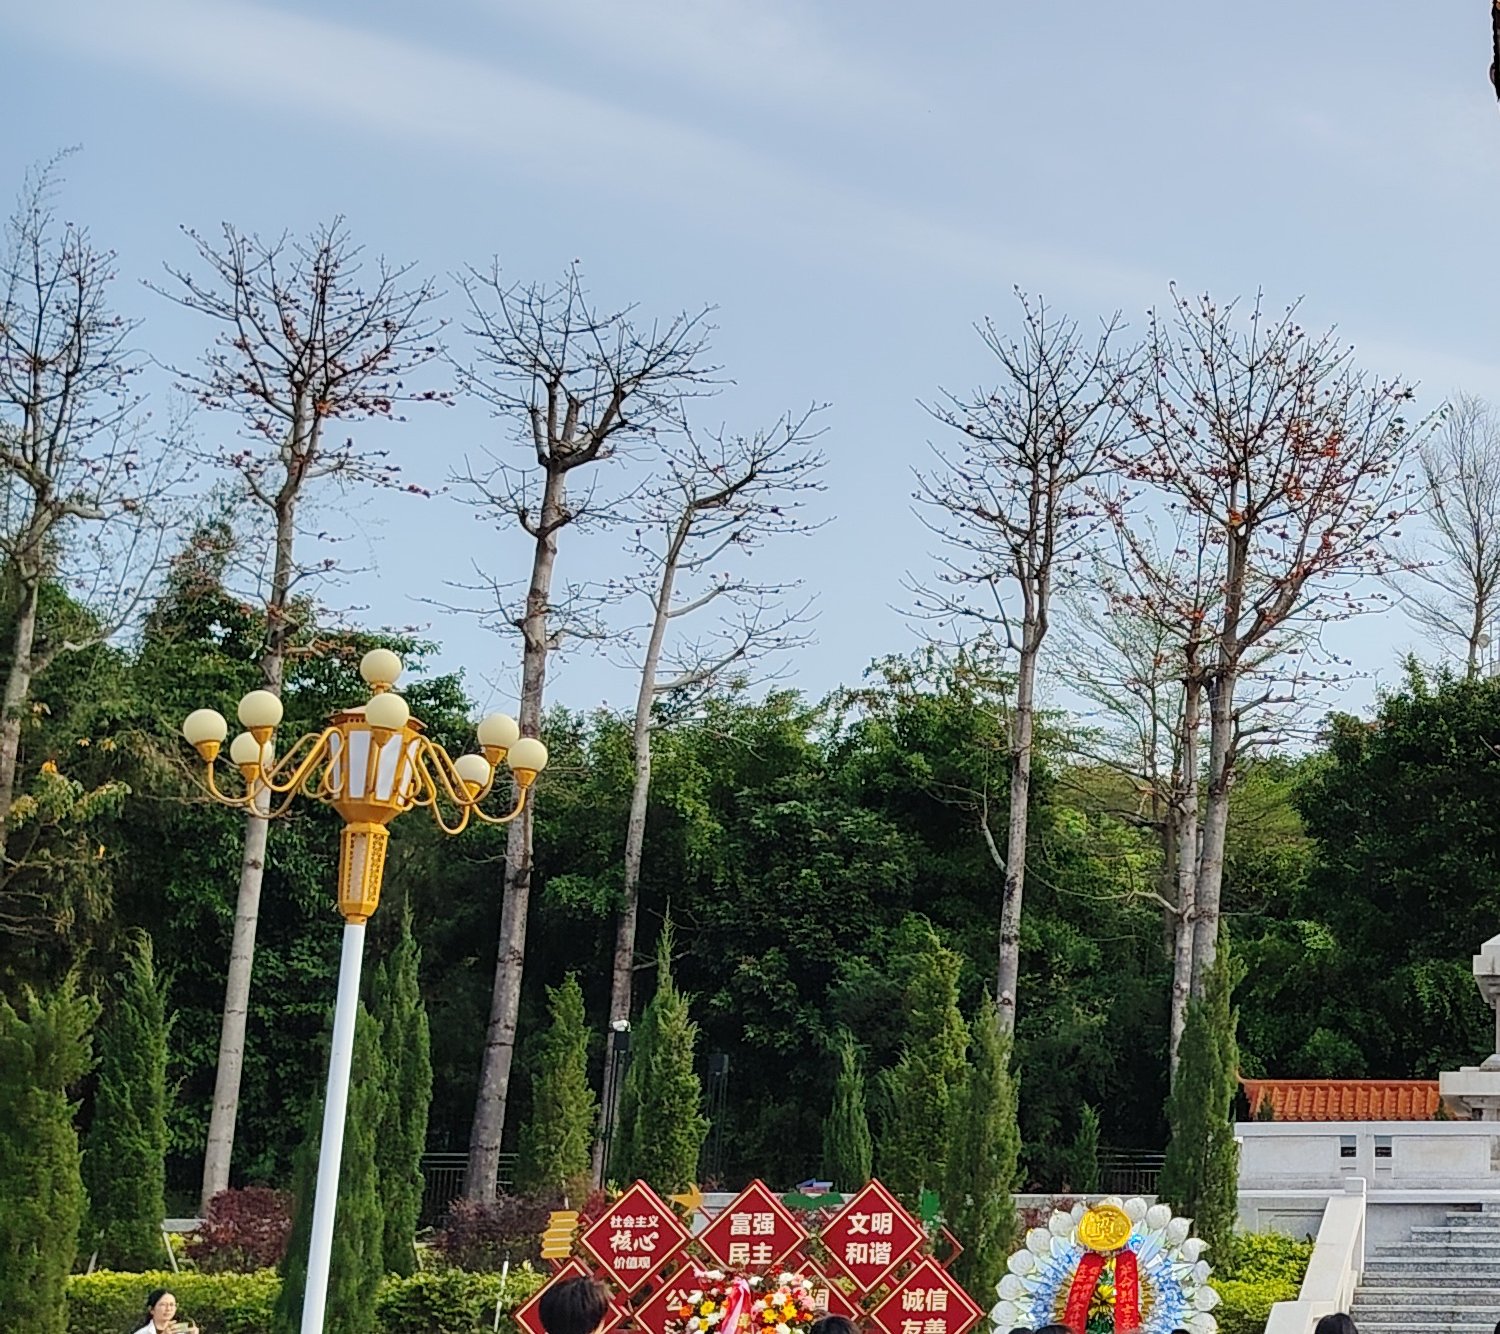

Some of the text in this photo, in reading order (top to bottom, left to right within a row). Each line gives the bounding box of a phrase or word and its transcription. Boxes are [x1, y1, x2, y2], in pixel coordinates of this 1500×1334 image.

[610, 1215, 659, 1228] 社会主义
[730, 1213, 775, 1236] 富强
[847, 1212, 893, 1235] 文明
[609, 1230, 659, 1253] 核心
[614, 1256, 650, 1269] 价值观
[729, 1243, 773, 1265] 民主
[847, 1242, 893, 1266] 和谐
[901, 1288, 948, 1312] 诚信
